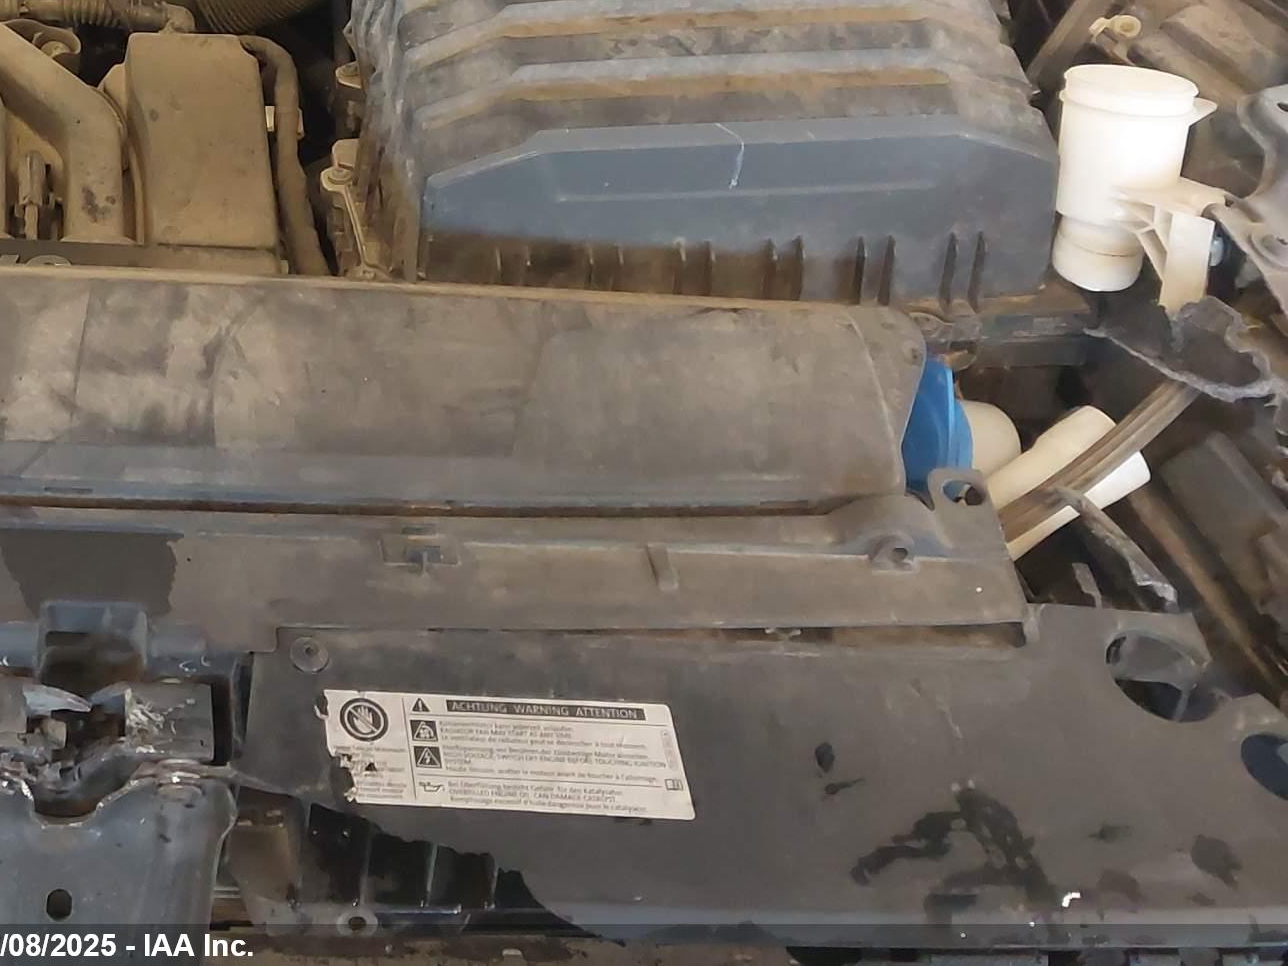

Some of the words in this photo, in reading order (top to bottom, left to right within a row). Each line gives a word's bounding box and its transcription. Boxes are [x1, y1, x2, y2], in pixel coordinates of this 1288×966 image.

[452, 701, 508, 714] ACHTUNG
[515, 703, 569, 716] WARNING
[575, 707, 637, 719] ATTENTION
